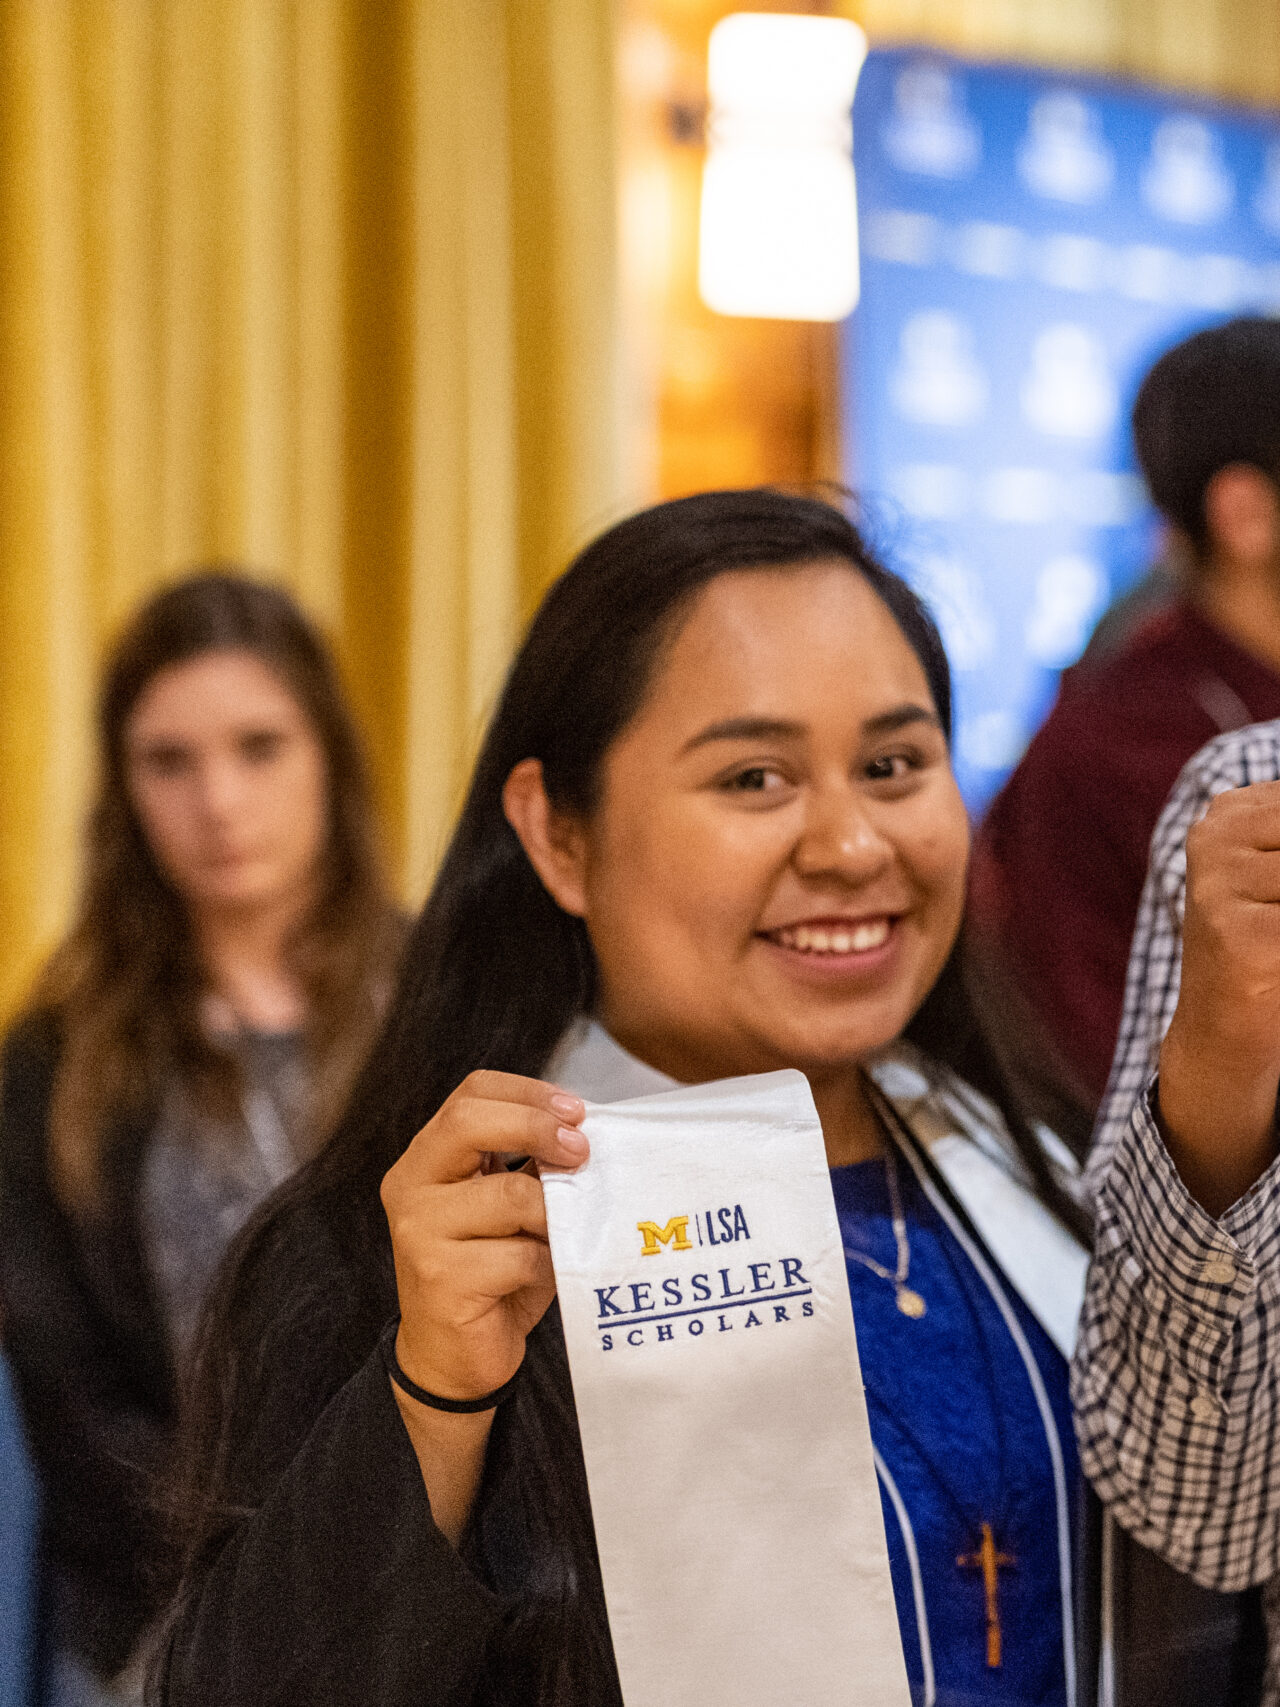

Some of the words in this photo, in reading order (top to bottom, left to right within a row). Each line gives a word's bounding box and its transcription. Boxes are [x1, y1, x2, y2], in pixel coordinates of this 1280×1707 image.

[637, 1215, 693, 1256] M
[705, 1204, 751, 1246] LSA
[593, 1257, 811, 1318] KESSLER
[601, 1302, 814, 1351] SCHOLARS
